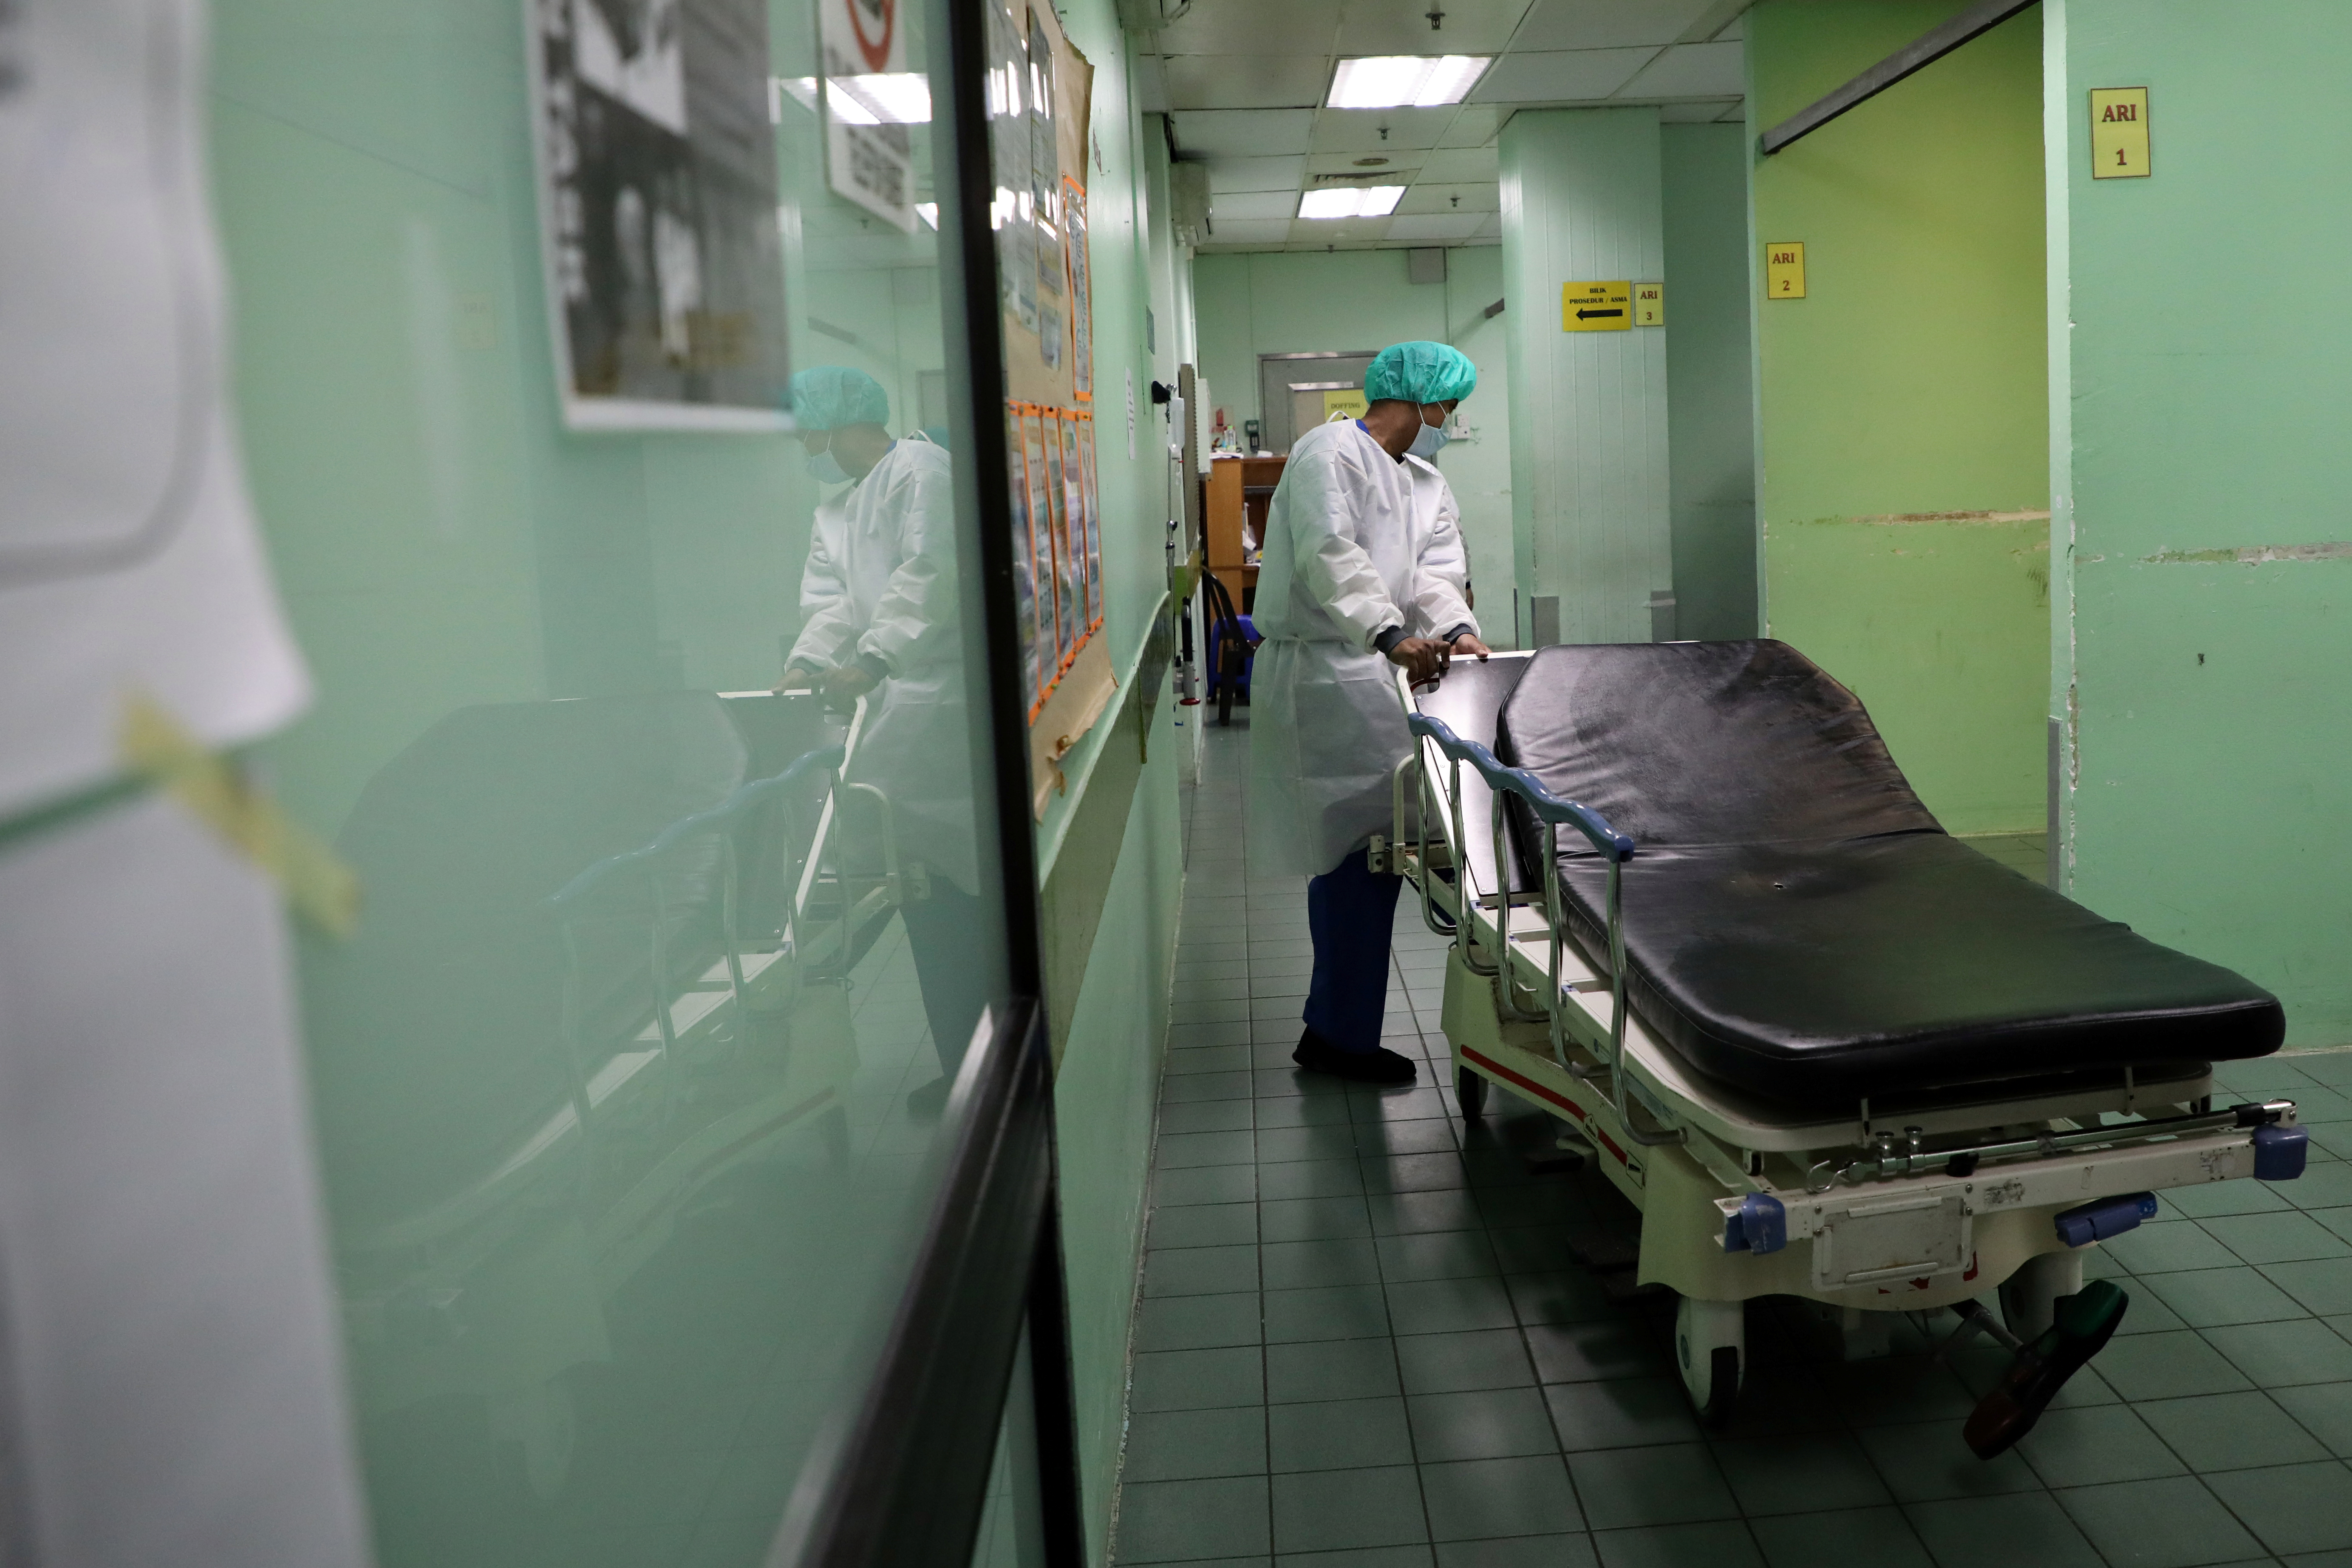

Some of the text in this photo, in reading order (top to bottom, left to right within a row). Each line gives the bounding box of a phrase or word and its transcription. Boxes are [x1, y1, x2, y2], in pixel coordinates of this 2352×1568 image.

[2102, 104, 2137, 122] ARI
[2117, 148, 2127, 165] 1
[1773, 252, 1795, 264] ARI
[1783, 280, 1790, 291] 2
[1640, 291, 1657, 300] ARI
[1646, 312, 1652, 320] 3
